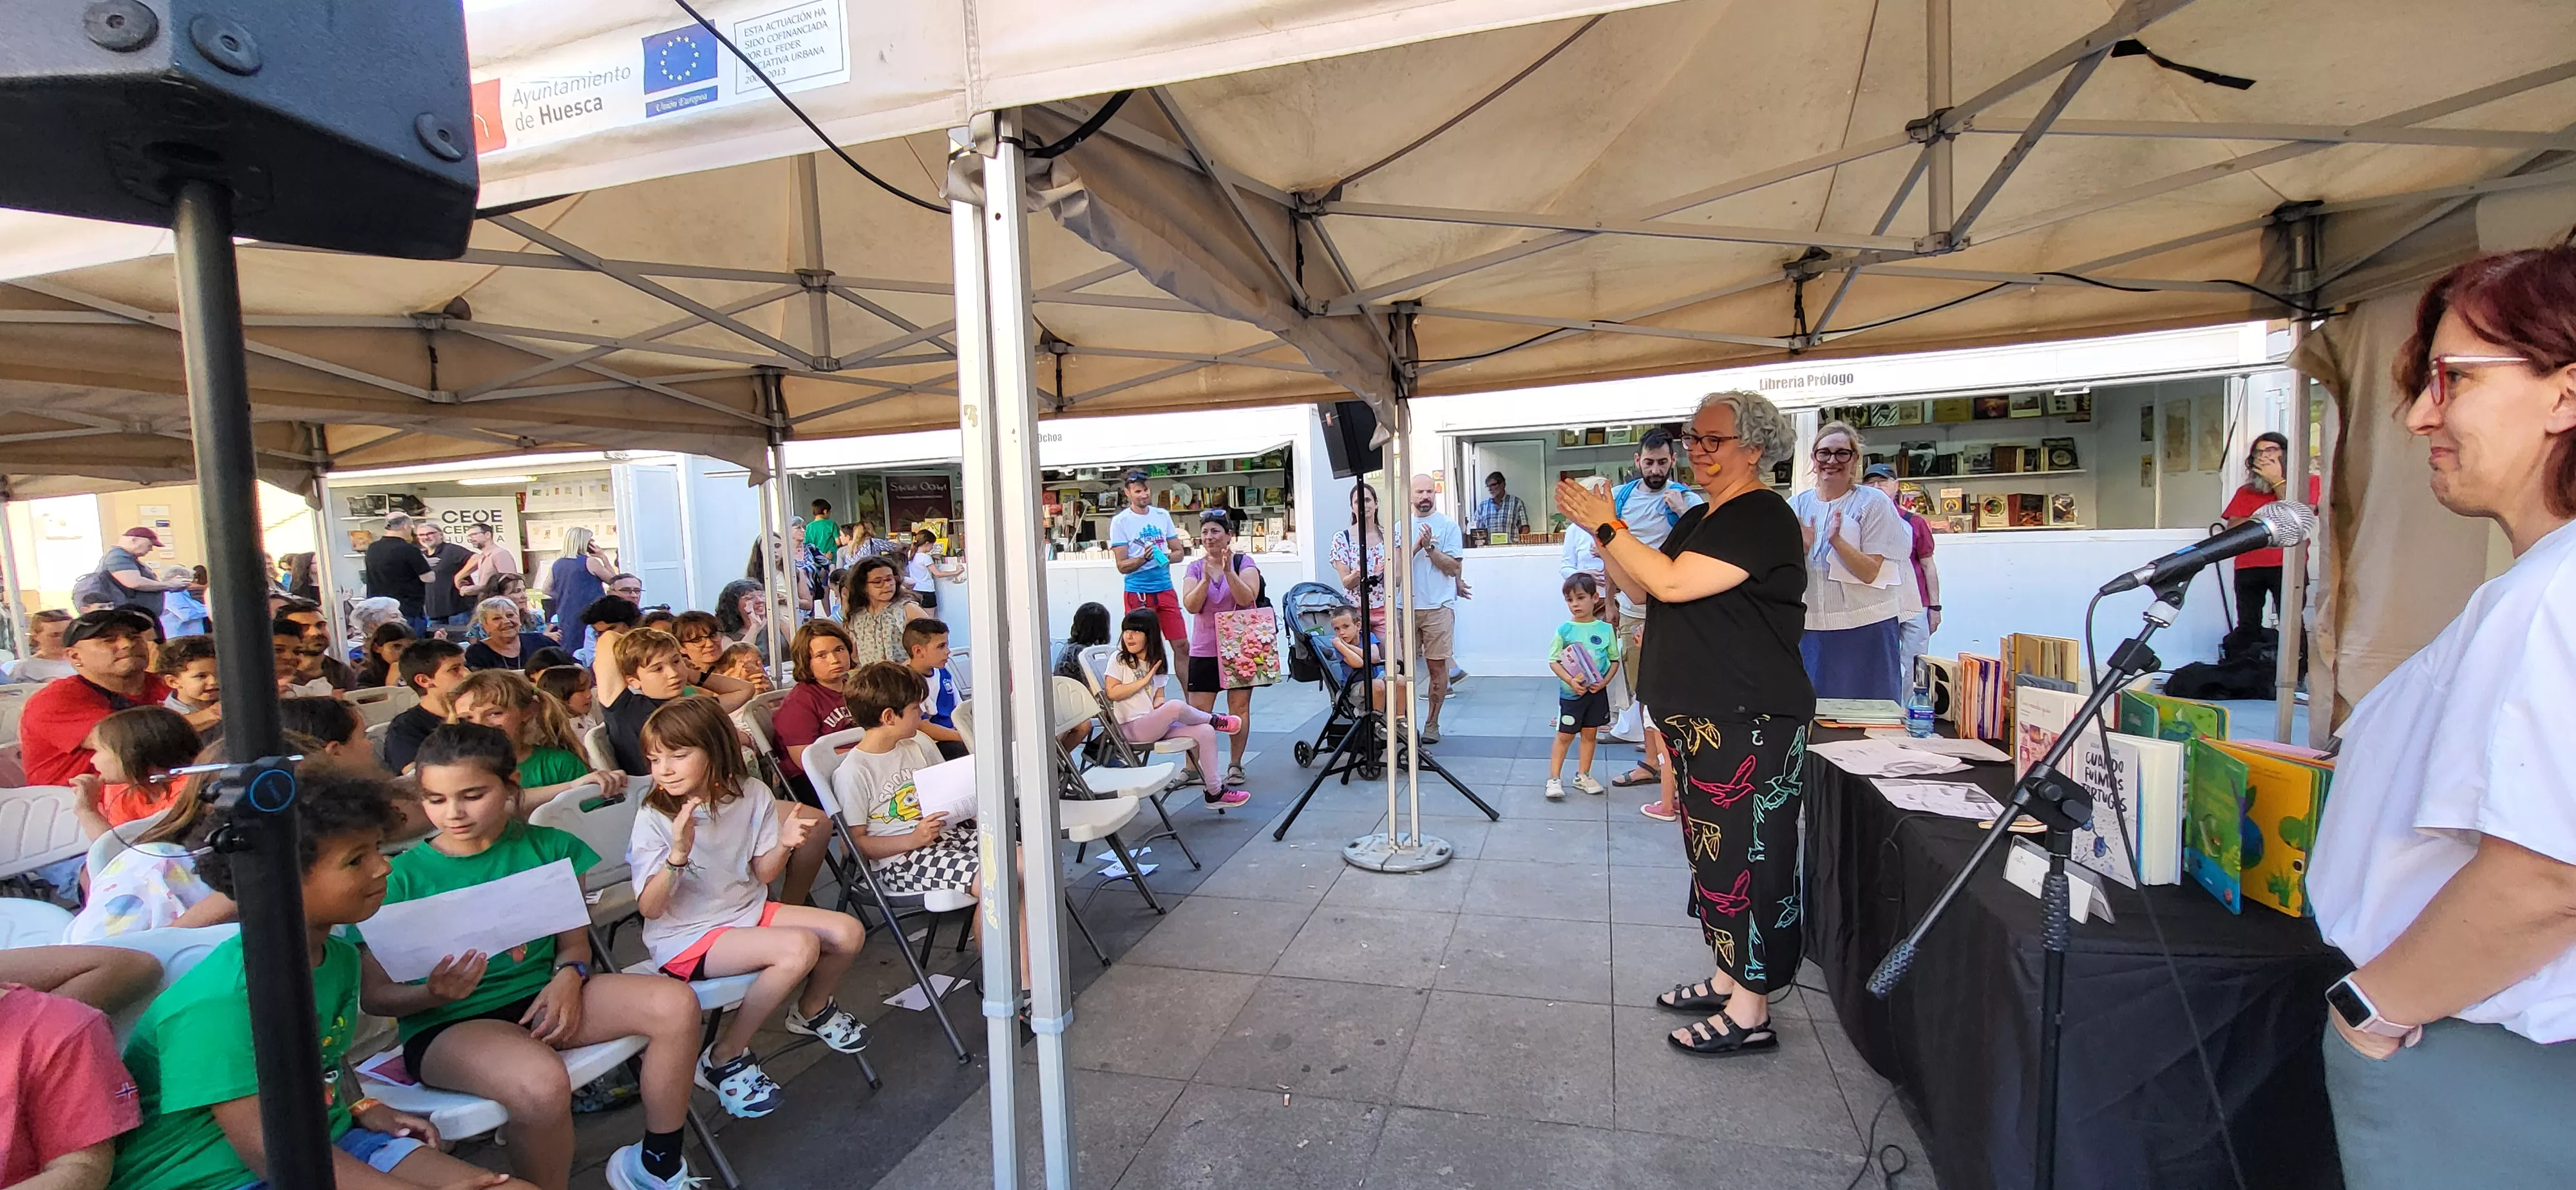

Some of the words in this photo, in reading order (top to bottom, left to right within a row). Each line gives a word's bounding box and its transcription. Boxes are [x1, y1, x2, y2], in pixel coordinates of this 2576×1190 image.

[744, 25, 764, 37] ESTA
[765, 10, 812, 32] ACTUACIÓN
[814, 7, 827, 19] HA
[744, 37, 765, 50] SIDO
[766, 20, 828, 43] COFINANCIADA
[744, 55, 790, 73] ICIATIVA
[791, 46, 825, 62] URBANA
[745, 50, 762, 60] OR
[764, 47, 773, 57] EL
[775, 39, 802, 53] FEDER
[512, 66, 631, 109] Ayuntamiento
[515, 111, 535, 131] de
[538, 96, 603, 126] Huesca
[1759, 375, 1804, 391] Librería
[1807, 372, 1854, 386] Prólogo
[1037, 433, 1062, 443] Ochoa
[441, 509, 503, 524] CEOE
[443, 524, 504, 534] CEPE
[2085, 766, 2123, 791] FUIMS
[2081, 782, 2127, 813] TORTUGS
